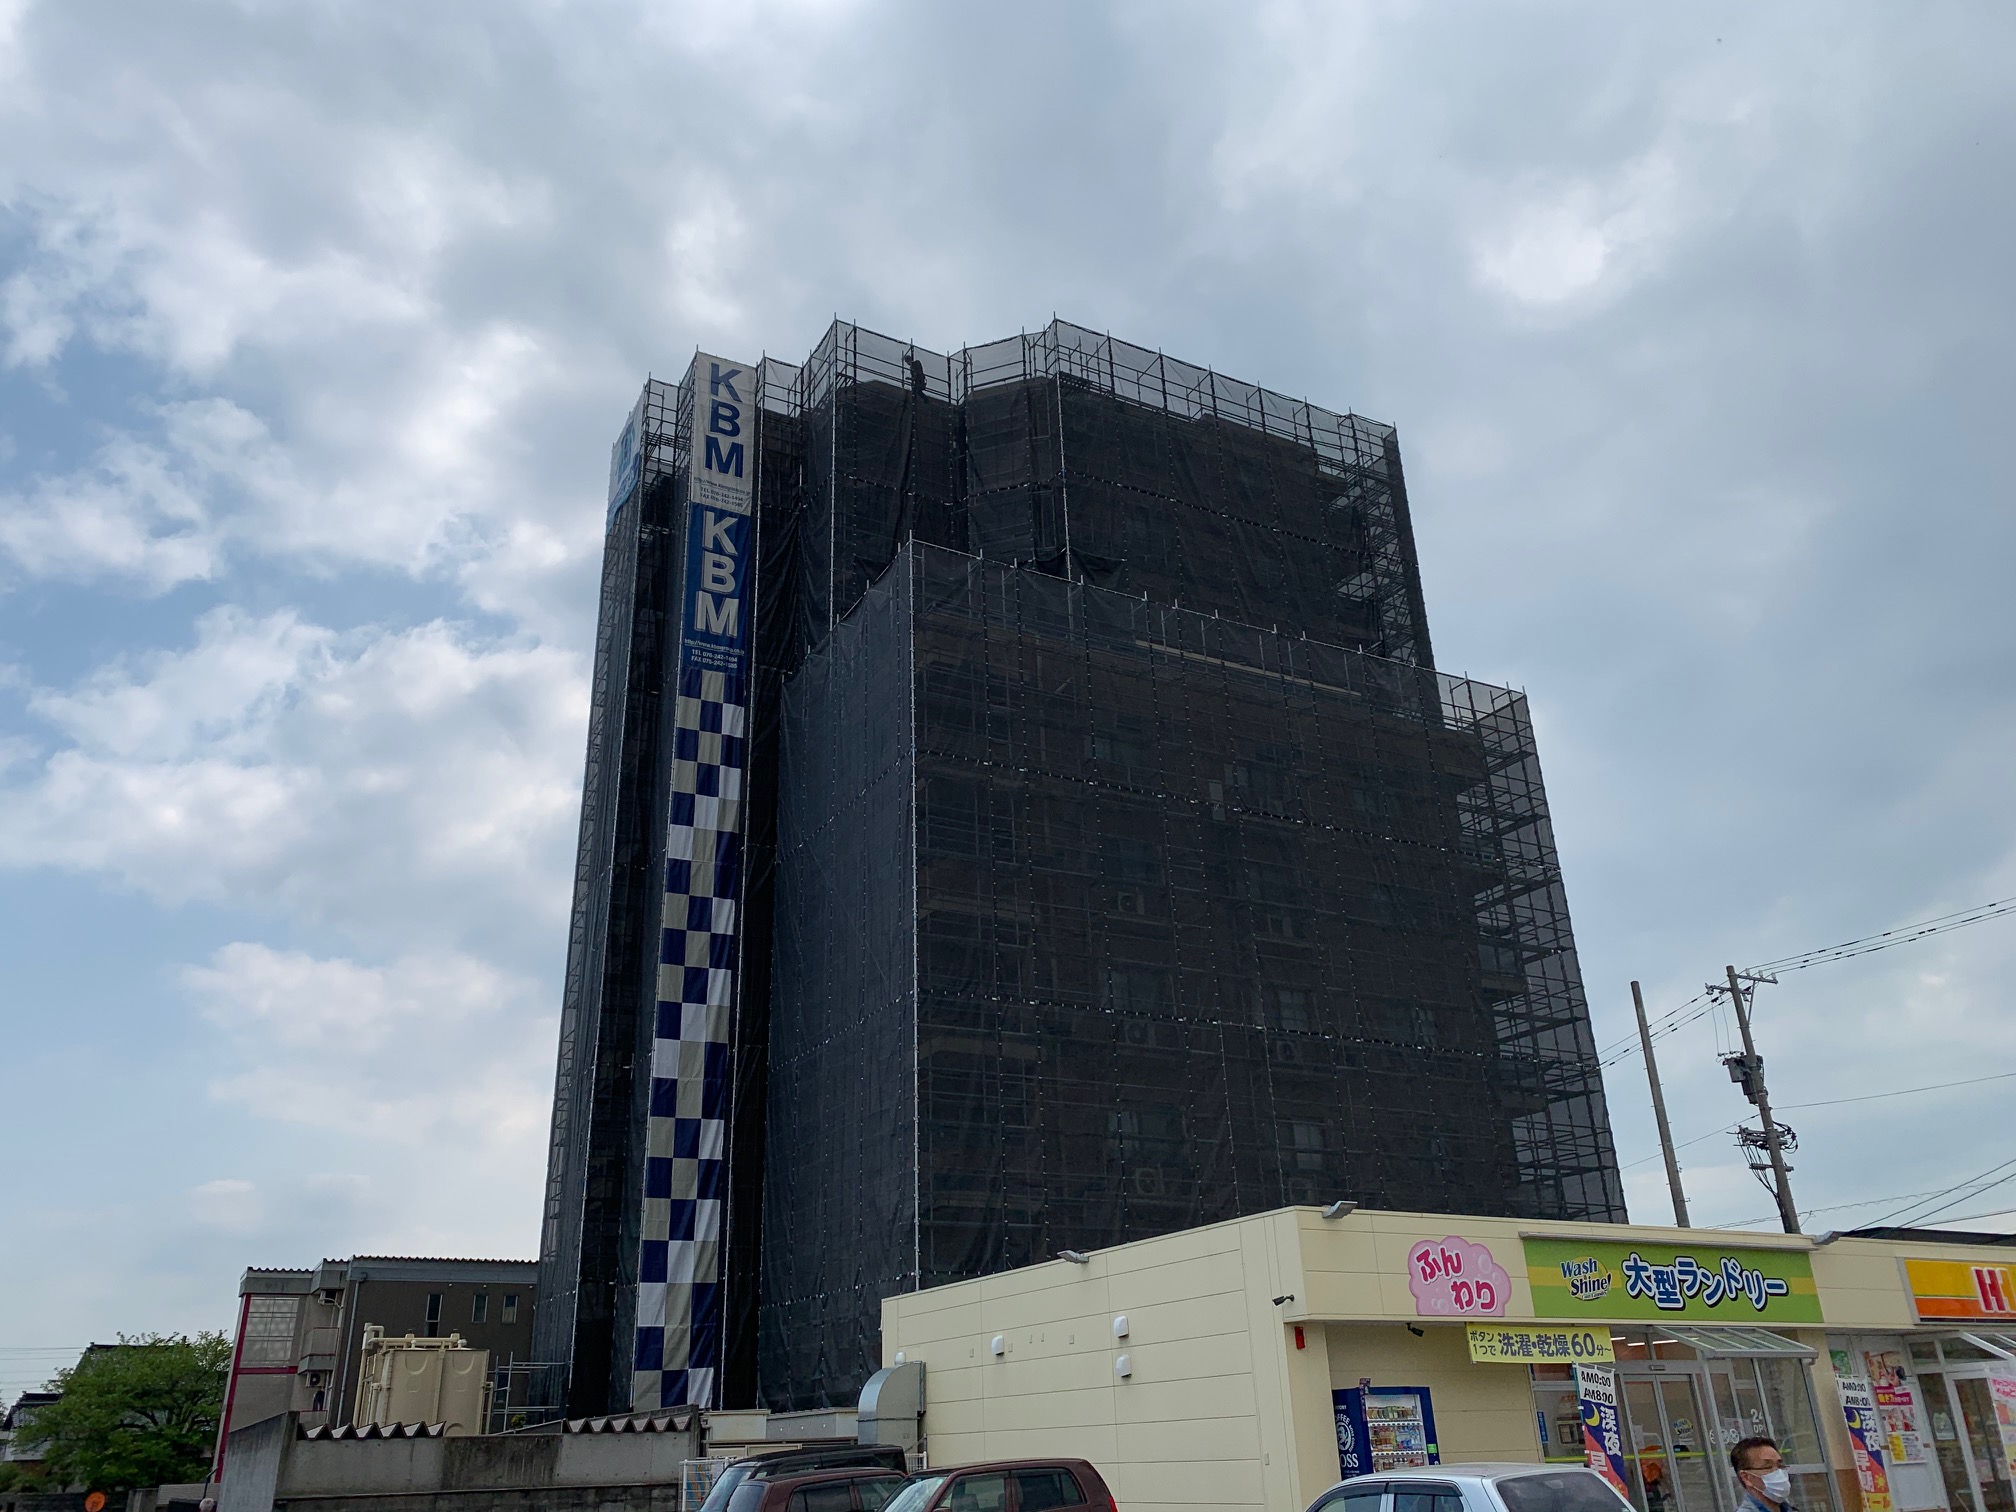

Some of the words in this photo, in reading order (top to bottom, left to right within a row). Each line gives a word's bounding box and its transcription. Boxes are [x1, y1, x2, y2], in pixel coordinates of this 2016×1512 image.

[705, 362, 743, 479] KBM
[700, 486, 710, 494] TEL
[694, 510, 739, 638] KBM
[691, 655, 702, 663] FAX
[1415, 1246, 1464, 1283] ふん
[1560, 1257, 1598, 1278] Wash
[1570, 1273, 1612, 1296] Shine!
[1623, 1253, 1787, 1310] 大型ランドリー
[1450, 1279, 1498, 1311] わり
[1470, 1331, 1495, 1342] ボタン
[1473, 1344, 1496, 1356] 1つで
[1581, 1371, 1611, 1388] AM0:00
[1600, 1406, 1621, 1457] 深夜
[1339, 1453, 1359, 1469] OSS
[1590, 1451, 1608, 1473] 早
